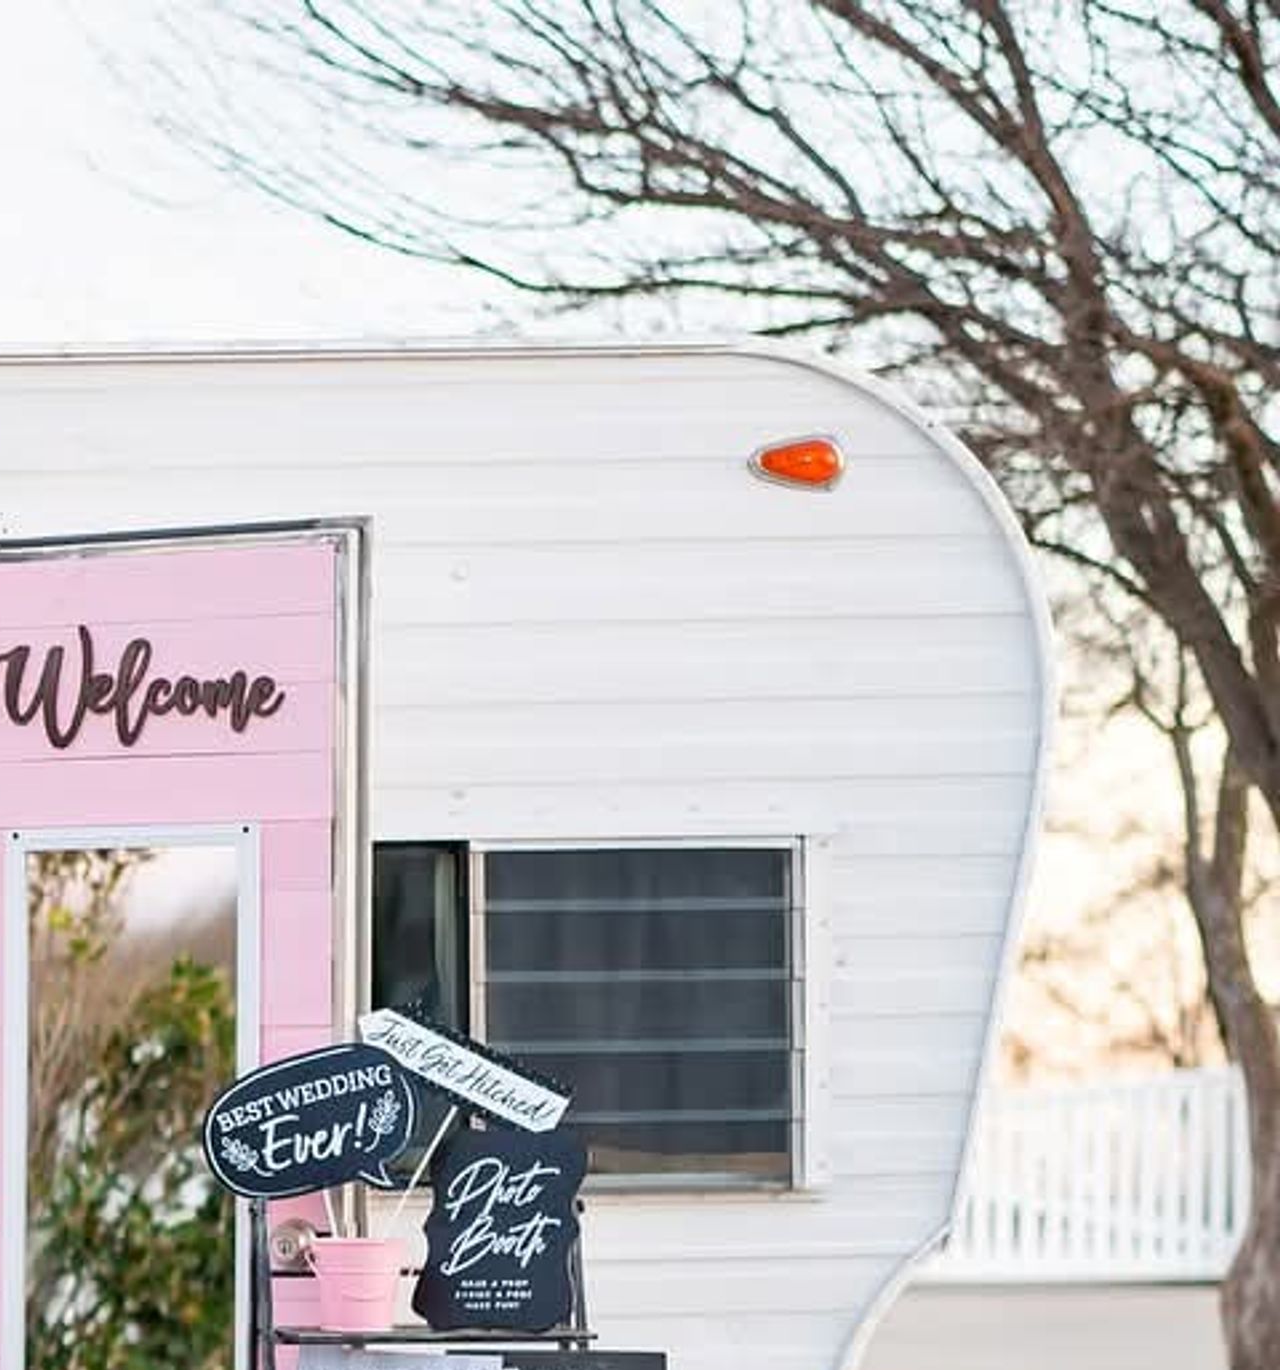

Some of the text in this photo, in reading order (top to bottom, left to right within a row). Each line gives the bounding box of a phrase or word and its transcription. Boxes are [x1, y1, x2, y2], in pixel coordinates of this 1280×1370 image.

[216, 1064, 392, 1133] BEST WEDDING
[368, 1018, 556, 1120] Just Got Hitched!
[258, 1101, 368, 1170] Ever!
[445, 1157, 561, 1221] Photo
[440, 1211, 562, 1276] Booth
